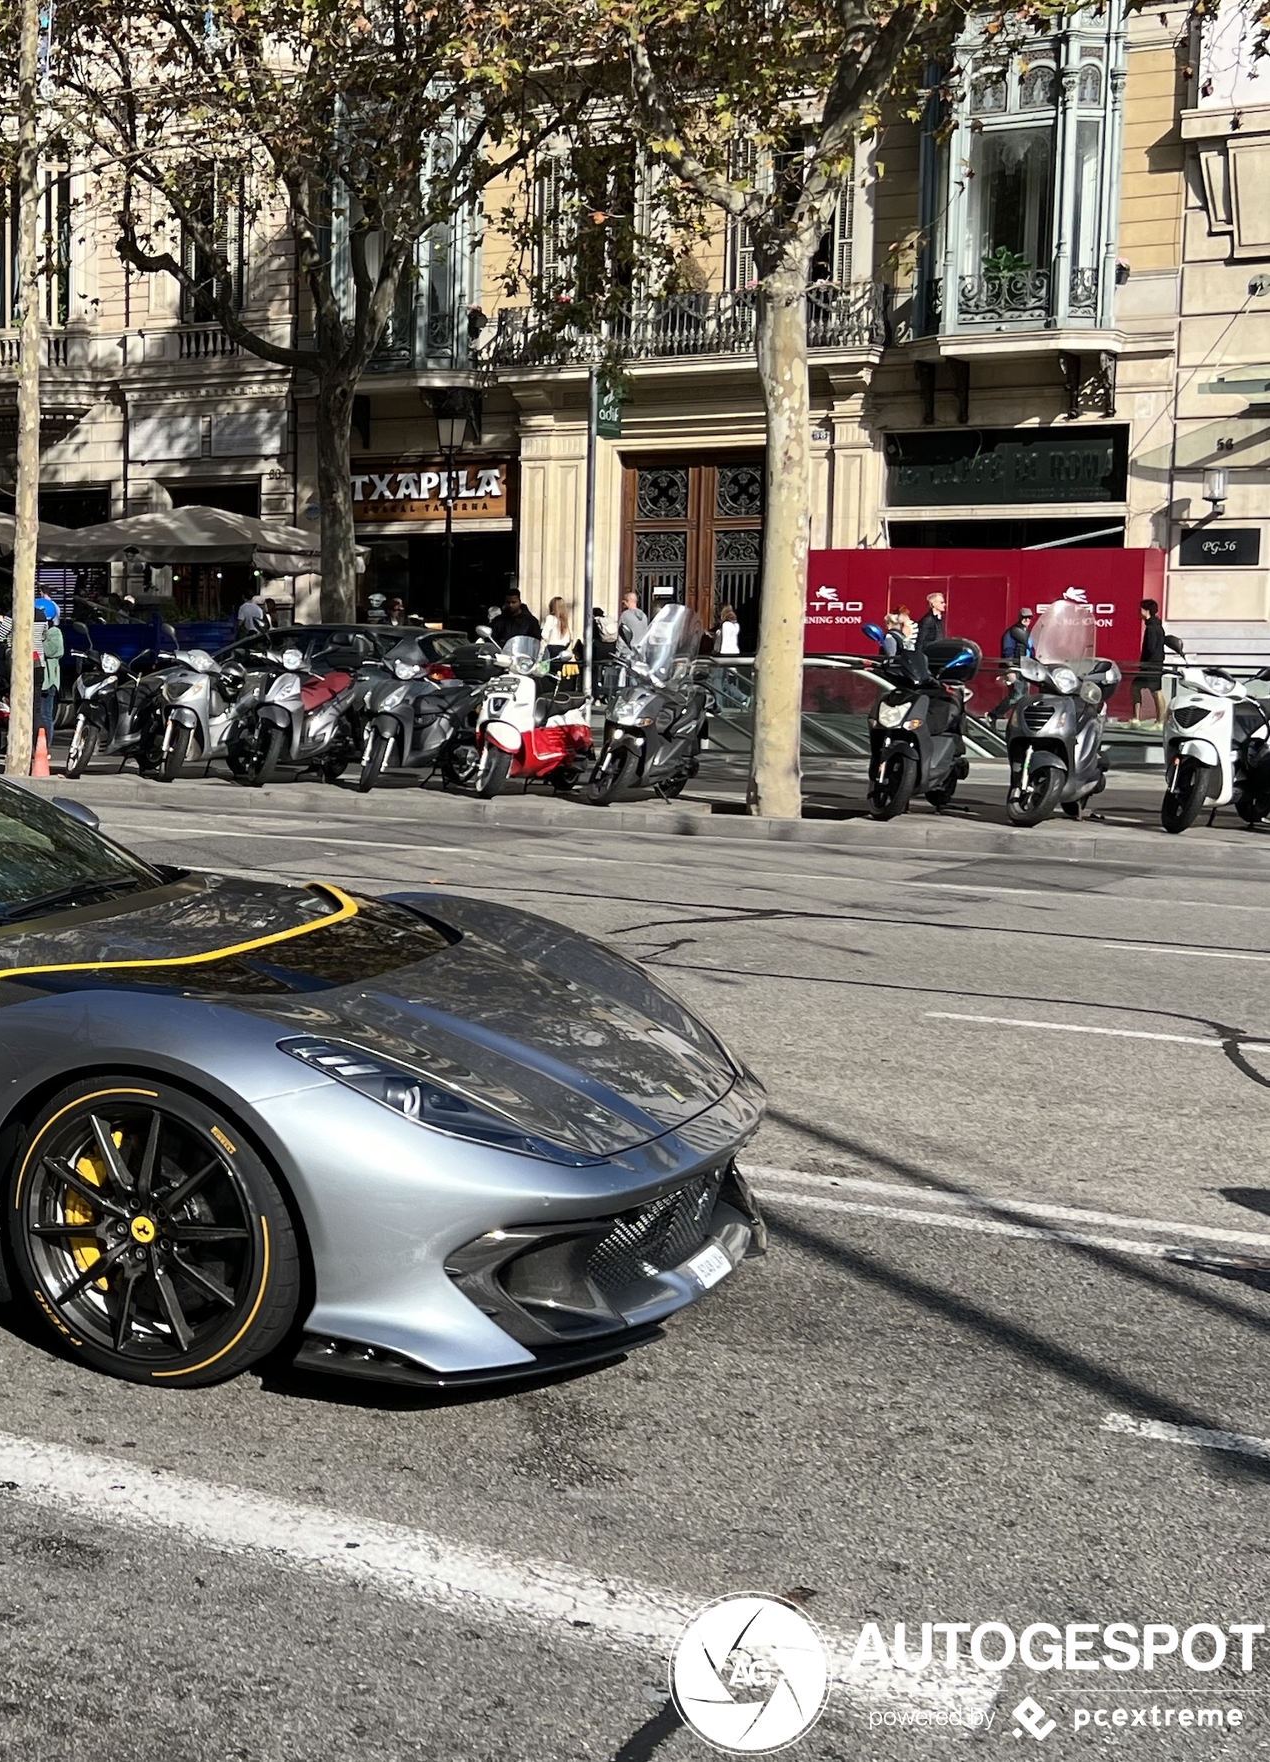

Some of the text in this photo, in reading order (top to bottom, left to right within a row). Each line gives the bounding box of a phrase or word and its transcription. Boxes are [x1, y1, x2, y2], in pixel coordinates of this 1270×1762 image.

[1216, 438, 1234, 451] 56
[805, 601, 863, 611] TRO
[834, 616, 862, 625] SOON
